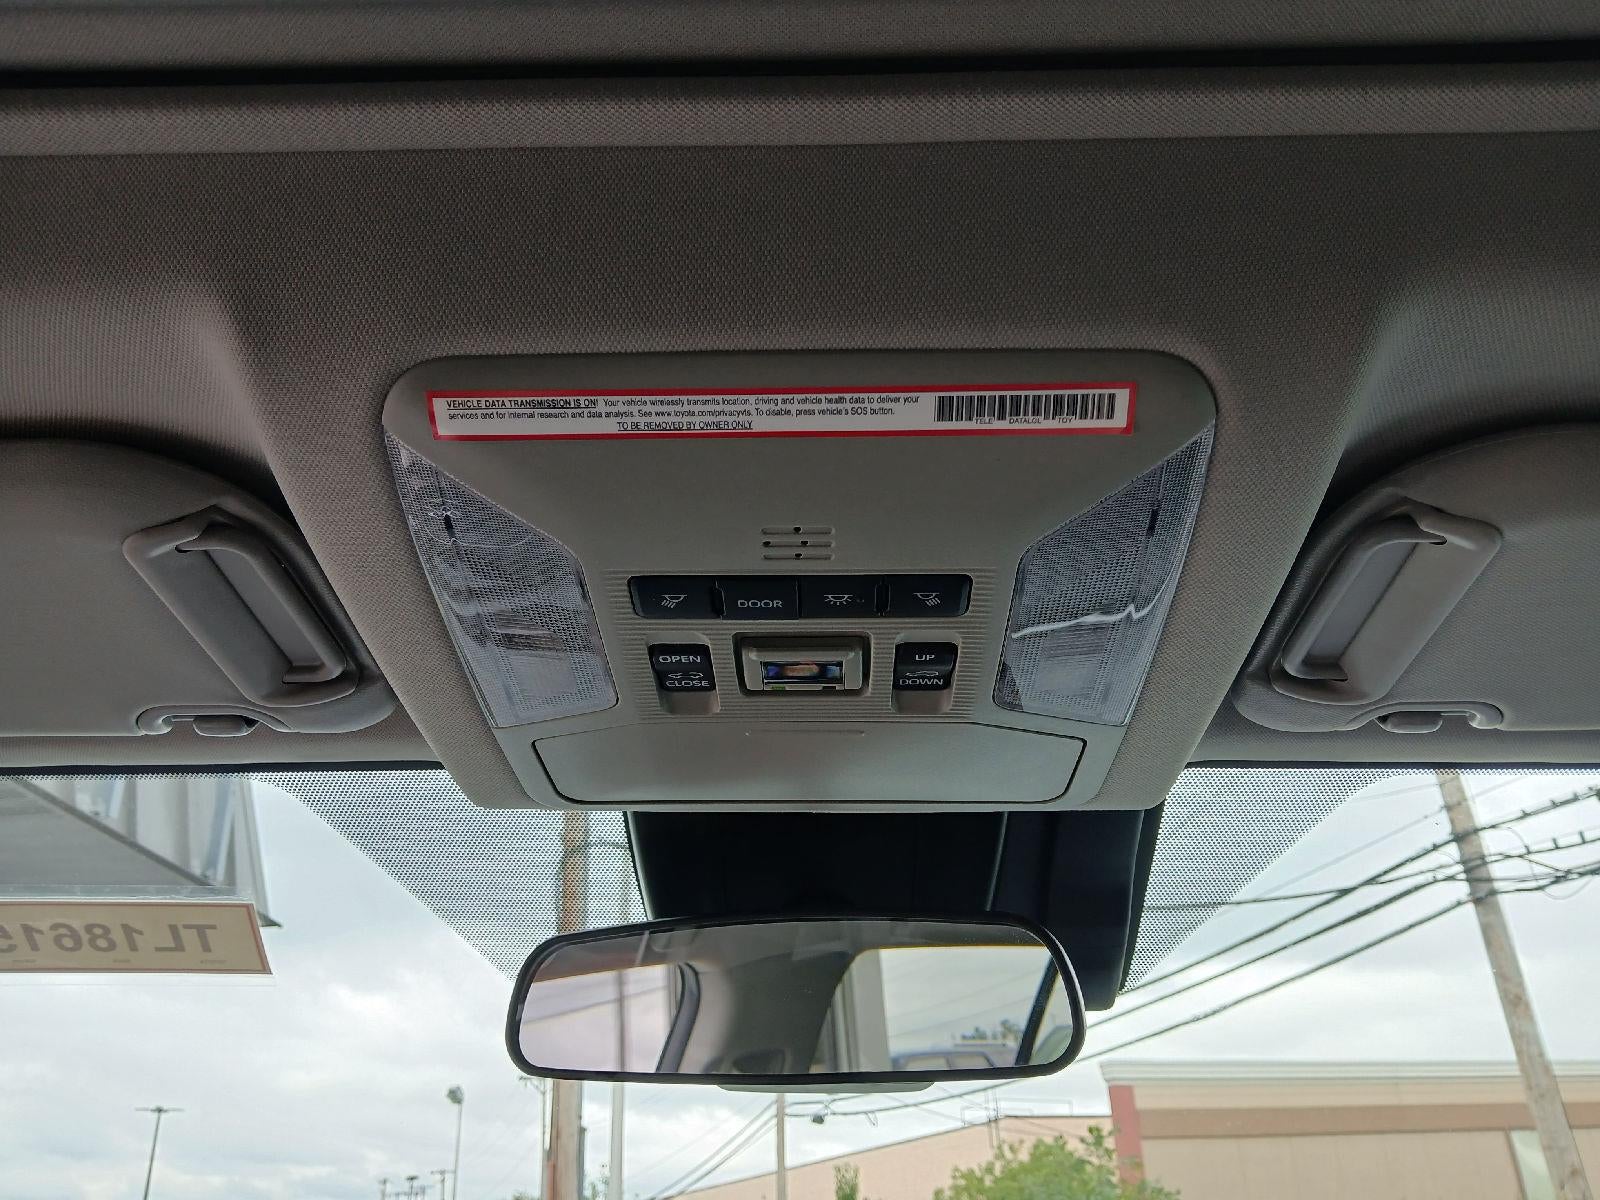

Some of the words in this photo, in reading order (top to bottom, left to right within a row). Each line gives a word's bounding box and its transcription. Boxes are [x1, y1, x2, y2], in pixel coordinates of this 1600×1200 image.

[446, 400, 482, 409] VEHICLE
[485, 400, 507, 408] DATA
[509, 399, 571, 409] TRANSMISSION
[573, 399, 582, 408] IS
[584, 399, 599, 408] ON!
[603, 398, 620, 407] Your
[622, 398, 647, 407] vehicle
[650, 398, 684, 408] wirelessly
[687, 398, 720, 407] transmits
[722, 397, 752, 407] location,
[754, 397, 779, 407] driving
[781, 396, 795, 405] and
[797, 396, 822, 405] vehicle
[824, 395, 847, 405] health
[849, 395, 865, 404] data
[867, 395, 875, 404] to
[876, 395, 901, 404] deliver
[903, 396, 920, 406] your
[448, 412, 479, 420] services
[481, 411, 494, 420] and
[496, 411, 506, 419] for
[508, 411, 536, 419] internal
[537, 410, 569, 419] research
[571, 410, 585, 419] and
[586, 410, 602, 418] data
[605, 409, 635, 419] analysis.
[638, 409, 653, 418] See
[755, 408, 763, 417] To
[765, 407, 793, 418] disable,
[796, 408, 816, 418] press
[818, 407, 849, 416] vehicle's
[850, 406, 868, 416] SOS
[870, 406, 895, 415] button.
[617, 421, 629, 430] TO
[631, 421, 642, 430] BE
[644, 421, 684, 430] REMOVED
[686, 420, 697, 429] BY
[699, 420, 729, 429] OWNER
[731, 420, 753, 429] ONLY
[737, 599, 783, 609] DOOR
[658, 655, 701, 664] OPEN
[915, 653, 935, 662] UP
[665, 679, 710, 688] CLOSE
[899, 677, 944, 686] DOWN
